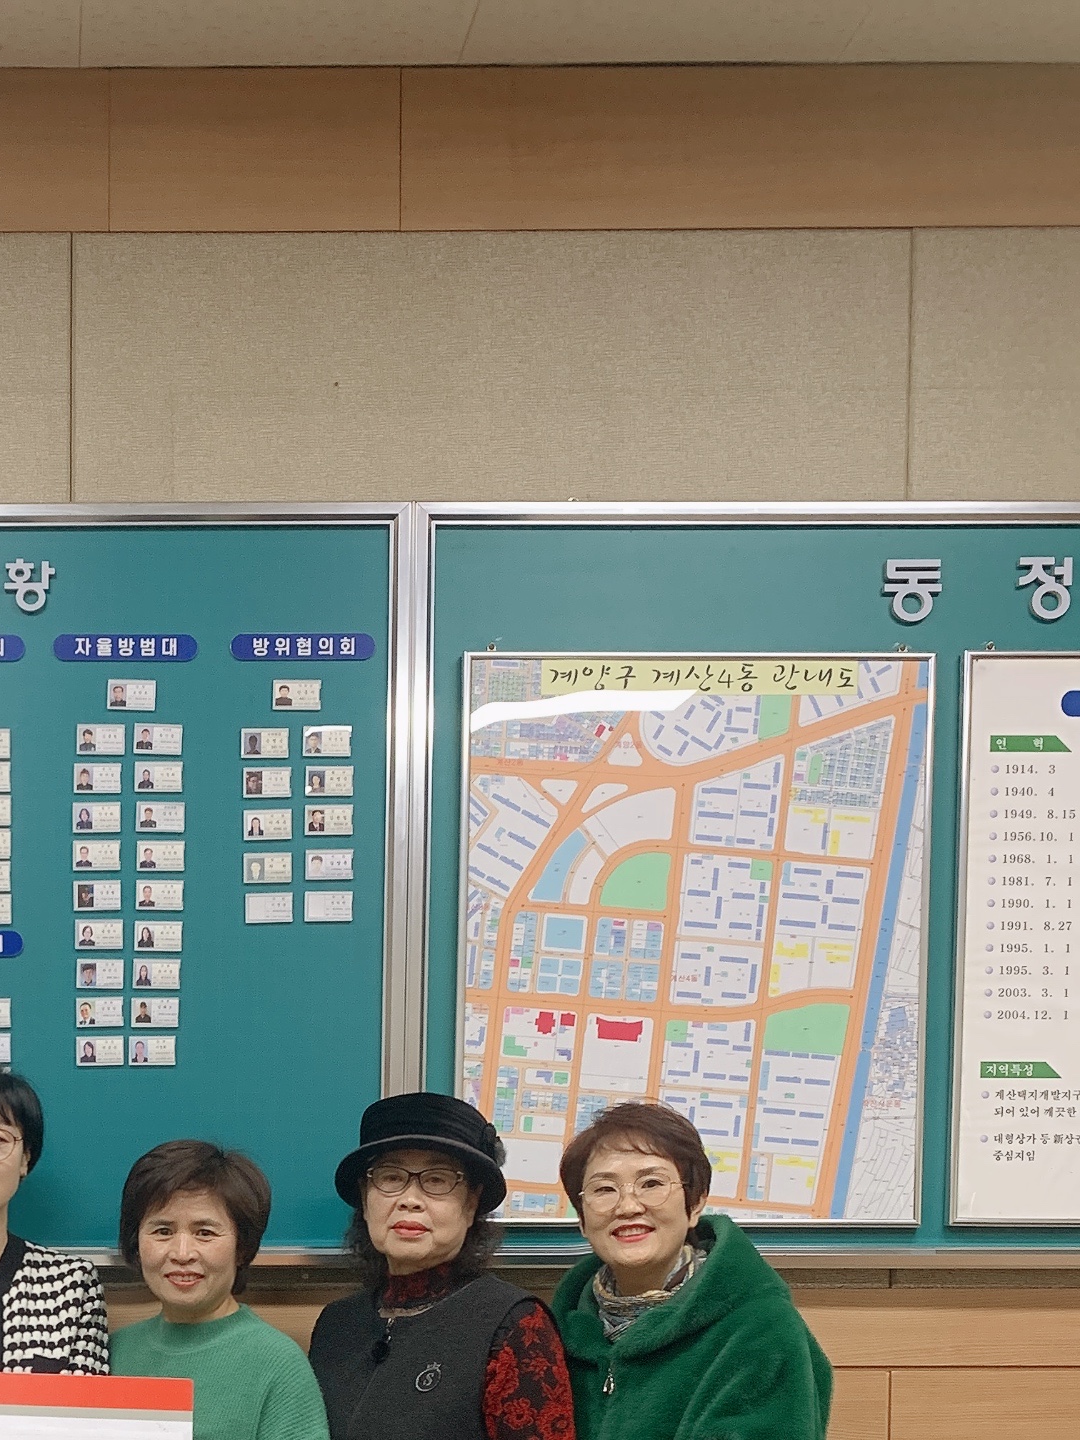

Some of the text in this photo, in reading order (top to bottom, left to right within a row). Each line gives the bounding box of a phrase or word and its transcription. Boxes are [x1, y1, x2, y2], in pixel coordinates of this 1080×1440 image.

[75, 638, 176, 656] 자율방범대
[253, 637, 354, 656] 방위협의회
[550, 663, 855, 692] 계양구 계산4동 관내도
[1005, 764, 1055, 774] 1914. 3
[1005, 787, 1055, 797] 1940. 4
[1004, 809, 1076, 819] 1949. 8.15
[1003, 832, 1074, 842] 1956.10. 1
[1003, 854, 1073, 864] 1968. 1. 1
[1002, 876, 1072, 886] 1981. 7. 1
[1001, 899, 1072, 909] 1990. 1. 1
[1001, 921, 1072, 931] 1991. 8.27
[1000, 943, 1070, 953] 1995. 1. 1
[999, 966, 1069, 976] 1995. 3. 1
[998, 988, 1069, 998] 2003. 3. 1
[997, 1010, 1068, 1020] 2004.12. 1
[985, 1063, 1033, 1076] 지역특성
[994, 1106, 1076, 1117] 되어 있어 깨끗한
[993, 1133, 1050, 1144] 대형상가 등
[993, 1150, 1035, 1161] 중심지임
